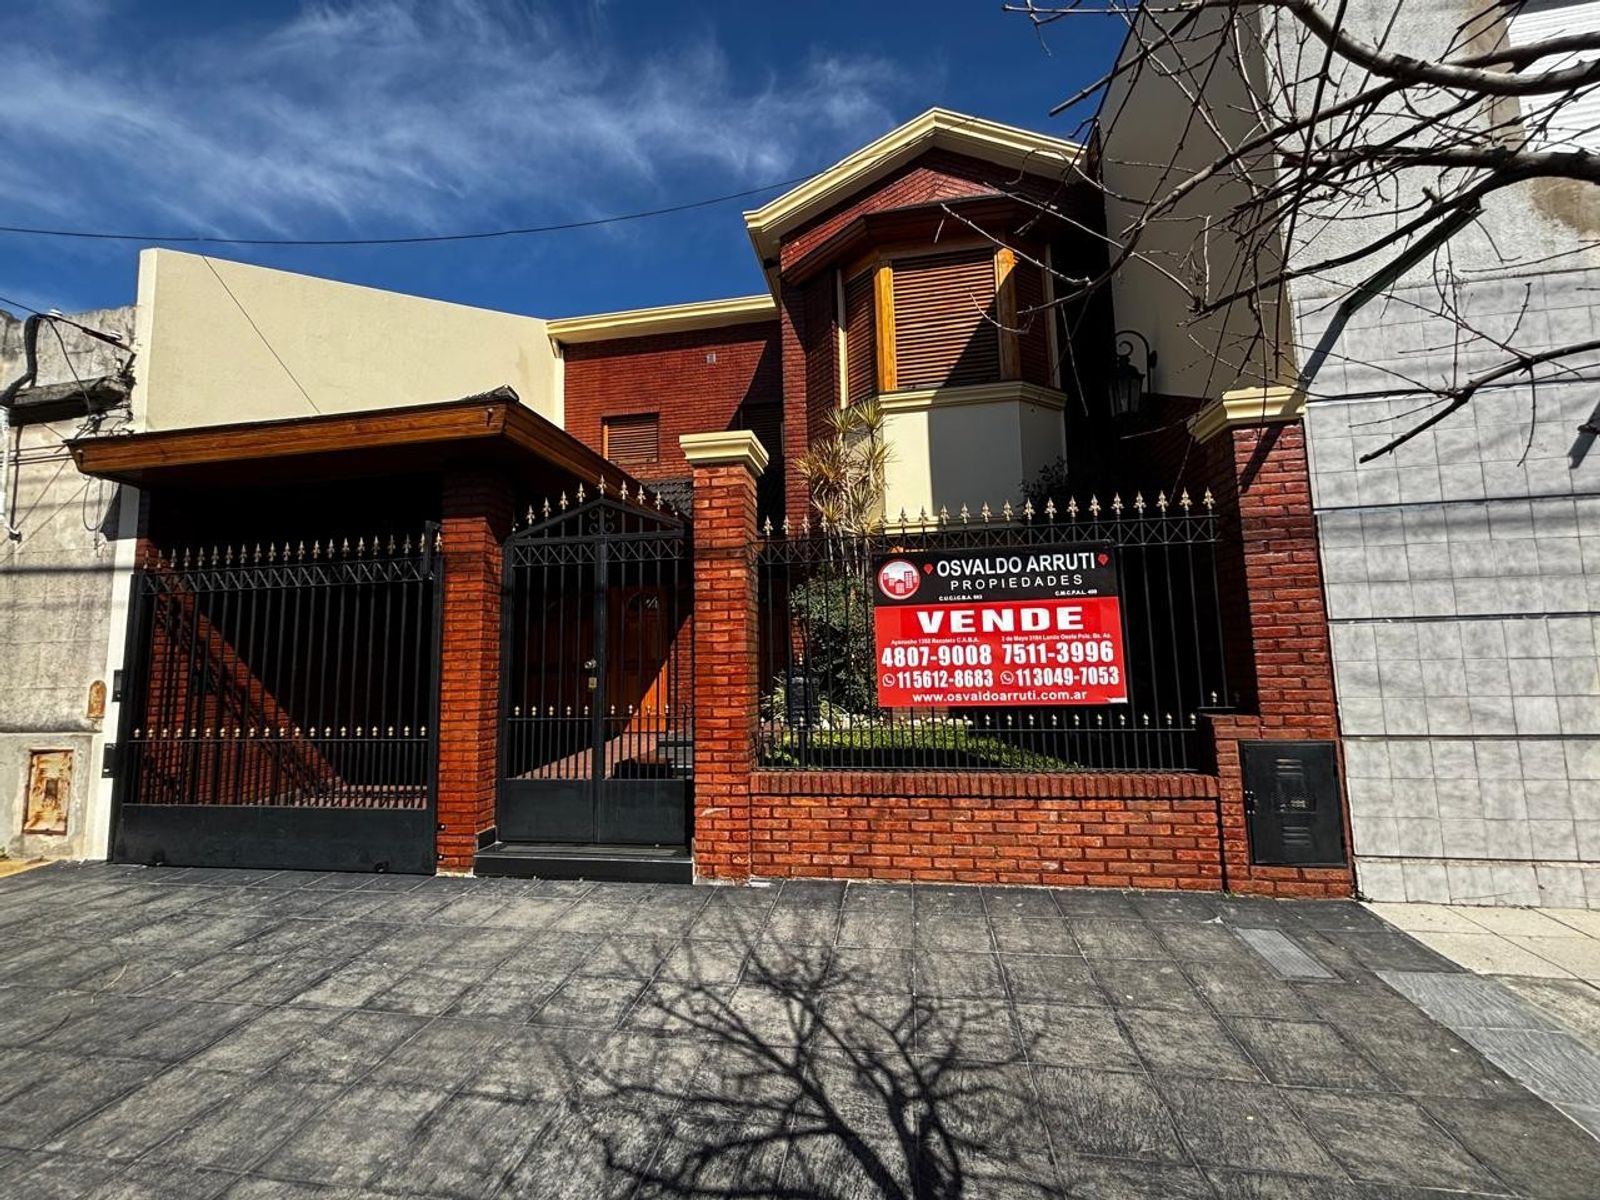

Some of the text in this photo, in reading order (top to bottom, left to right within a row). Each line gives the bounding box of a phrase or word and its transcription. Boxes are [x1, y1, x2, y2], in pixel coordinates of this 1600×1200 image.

[937, 552, 1096, 577] OSVALDO ARRUTI
[950, 574, 1083, 591] PROPIEDADES
[916, 606, 1084, 634] VENDE
[881, 644, 992, 667] 4807-9008
[1002, 641, 1114, 665] 7511-3996
[912, 690, 1088, 703] www.osvaldoarruti.com.ar
